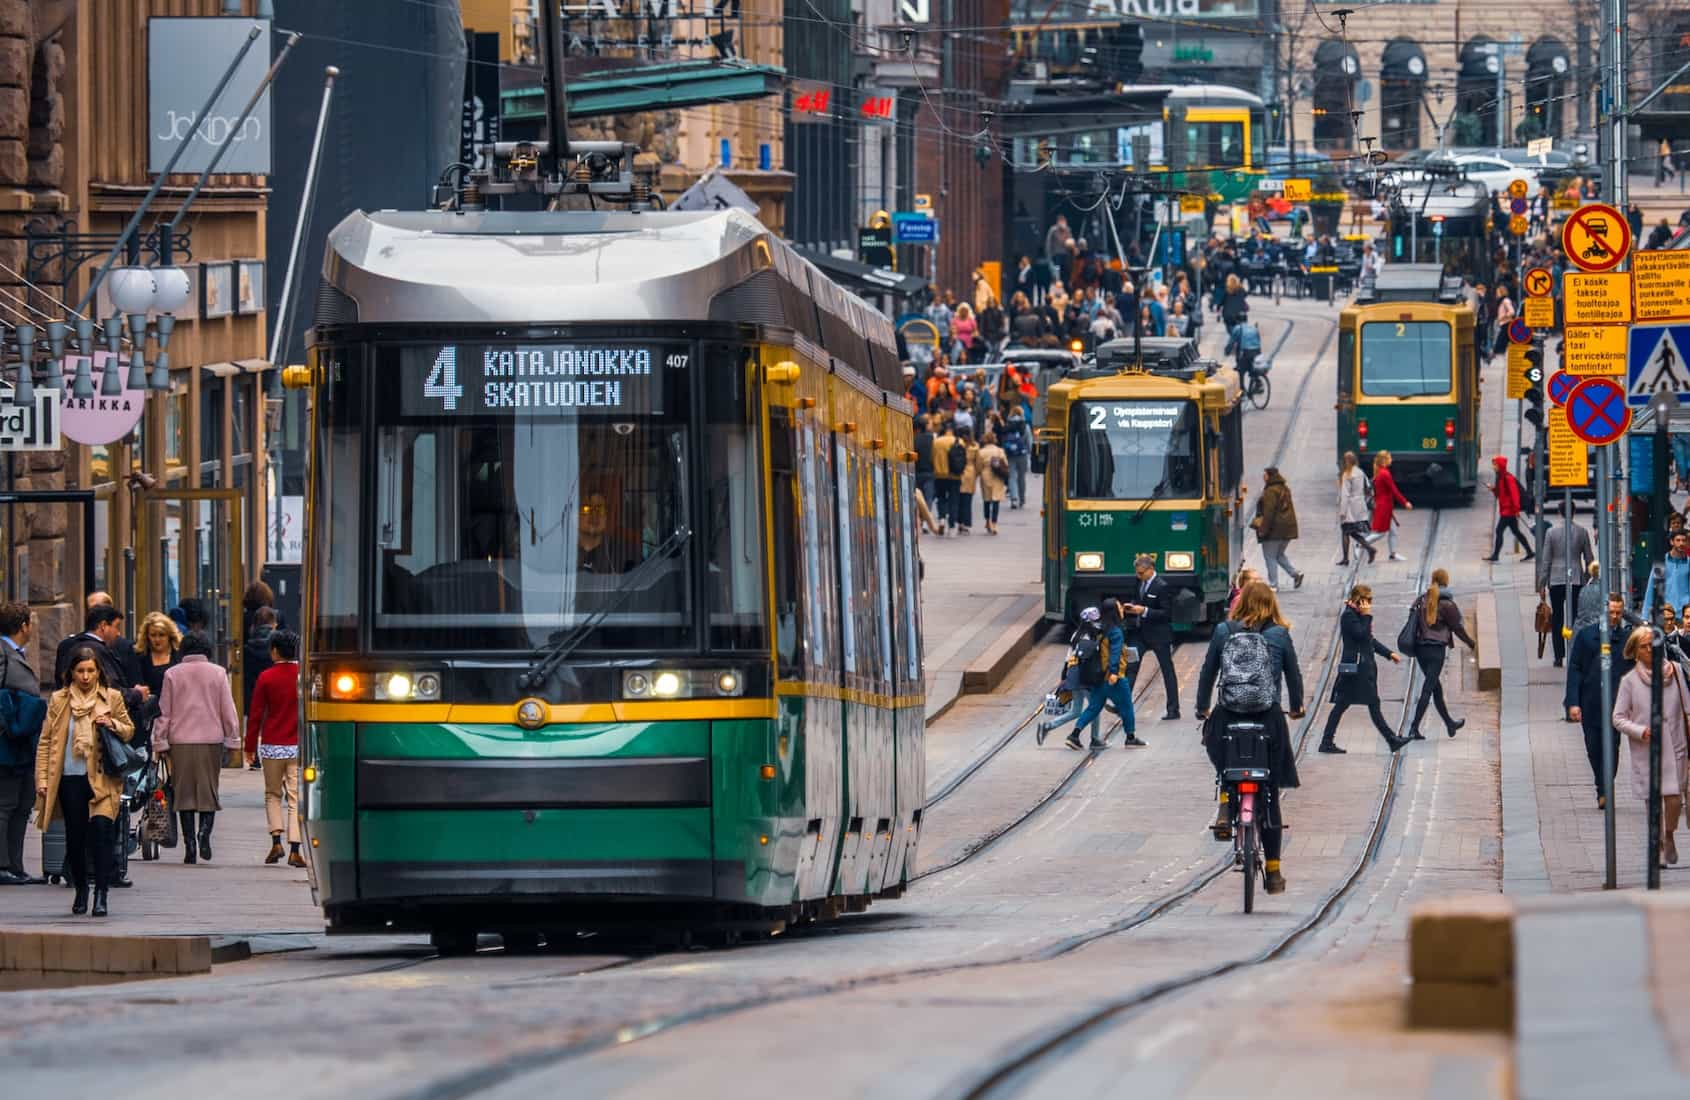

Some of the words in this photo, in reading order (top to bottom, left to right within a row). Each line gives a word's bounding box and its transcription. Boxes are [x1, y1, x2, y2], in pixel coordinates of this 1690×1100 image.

[1584, 277, 1609, 286] koske
[1395, 323, 1406, 337] 2
[424, 347, 463, 410] 4
[484, 350, 651, 376] KATAJANOKKA
[665, 354, 689, 369] 407
[484, 381, 620, 407] SKATUDDEN
[1089, 406, 1107, 430] 2
